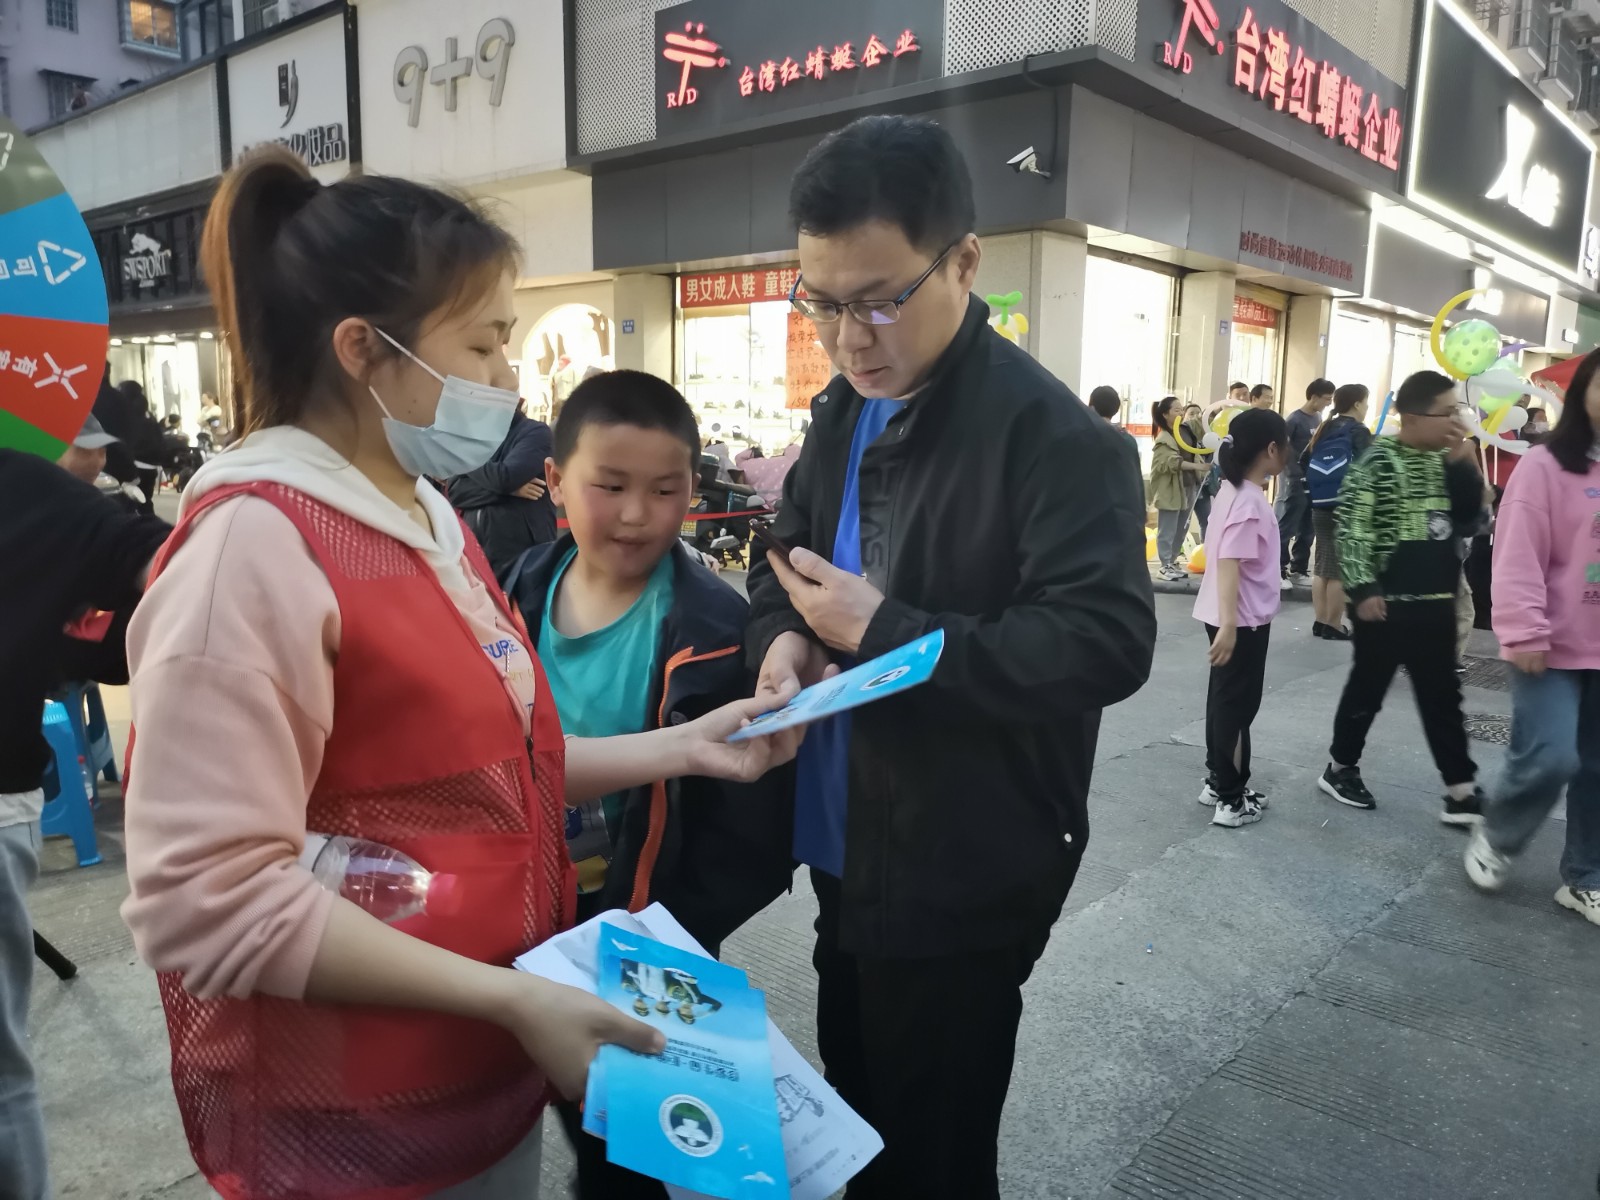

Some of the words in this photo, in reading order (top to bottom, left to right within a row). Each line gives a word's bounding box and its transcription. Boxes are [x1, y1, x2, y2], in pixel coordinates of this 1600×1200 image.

[738, 29, 918, 97] 台湾红蜻蜓企业
[1234, 7, 1401, 170] 台湾红蜻蜓企业
[686, 274, 755, 302] 男女成人鞋
